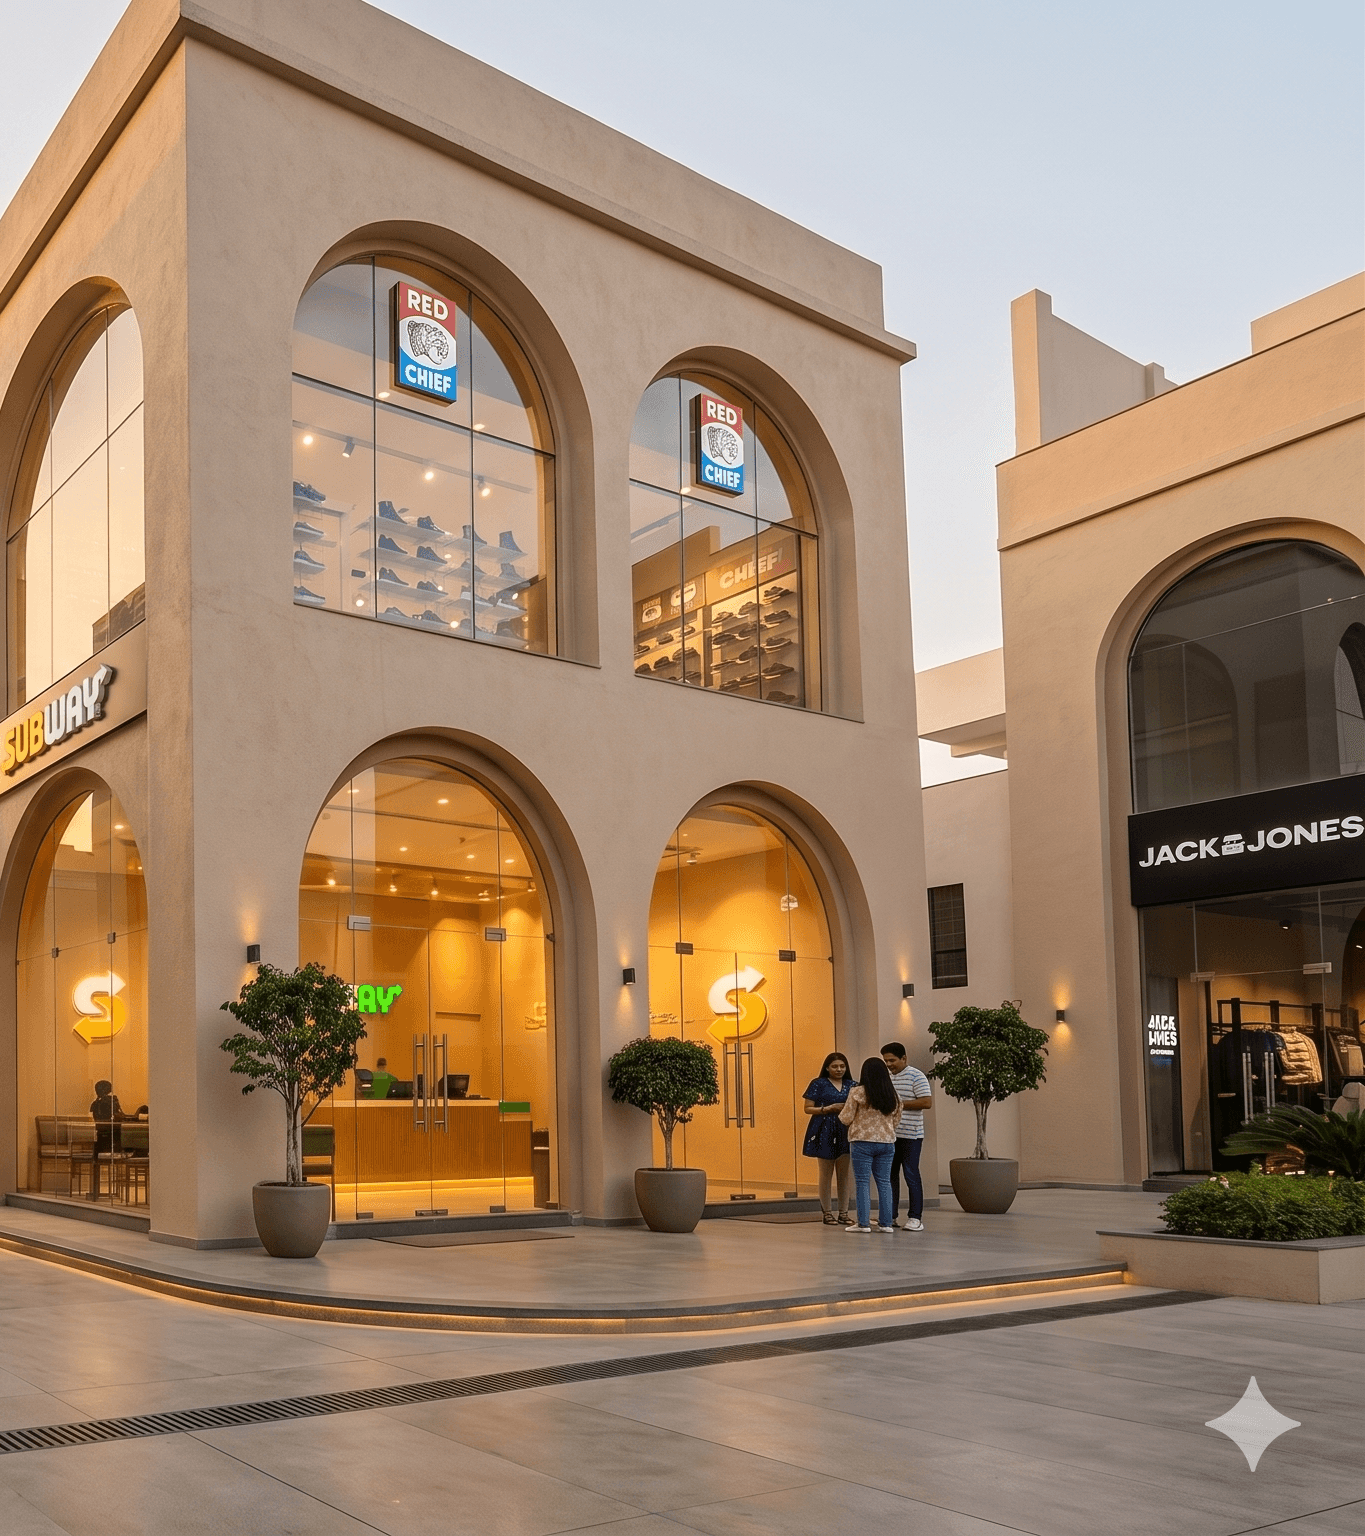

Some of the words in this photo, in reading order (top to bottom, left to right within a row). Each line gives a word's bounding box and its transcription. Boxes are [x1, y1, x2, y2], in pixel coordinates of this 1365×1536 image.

[407, 289, 450, 321] RED
[404, 364, 452, 394] CHIEF
[706, 399, 738, 426] RED
[704, 463, 741, 488] CHIEF
[0, 663, 113, 776] SUBWAY
[1138, 836, 1221, 868] JACK
[1247, 815, 1365, 853] JONES
